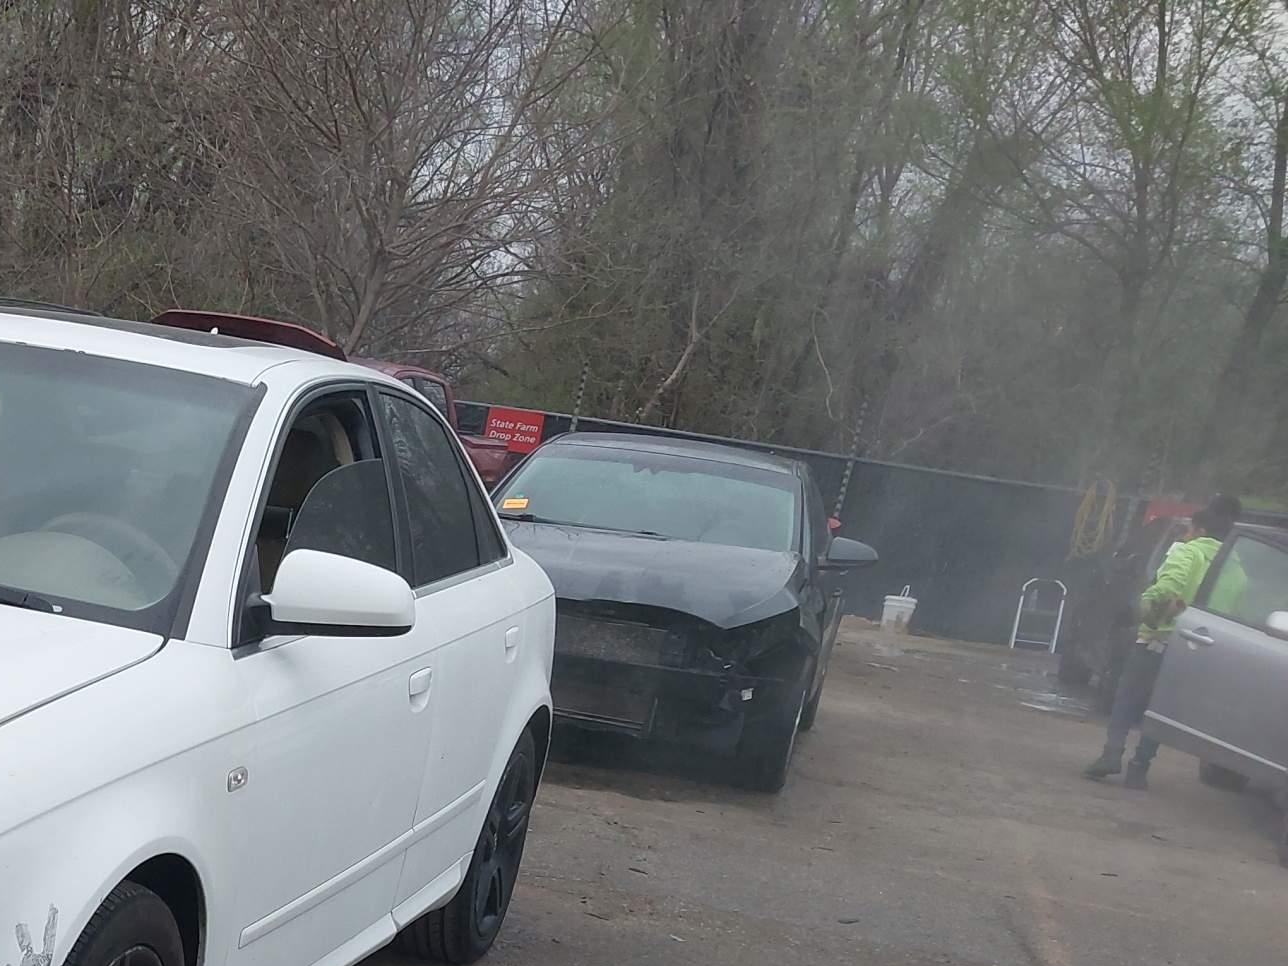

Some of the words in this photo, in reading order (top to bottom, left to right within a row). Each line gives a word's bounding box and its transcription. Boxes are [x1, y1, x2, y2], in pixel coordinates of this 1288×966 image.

[490, 419, 514, 430] State
[515, 422, 538, 433] Farm
[489, 430, 511, 441] Drop
[513, 433, 536, 443] Zone
